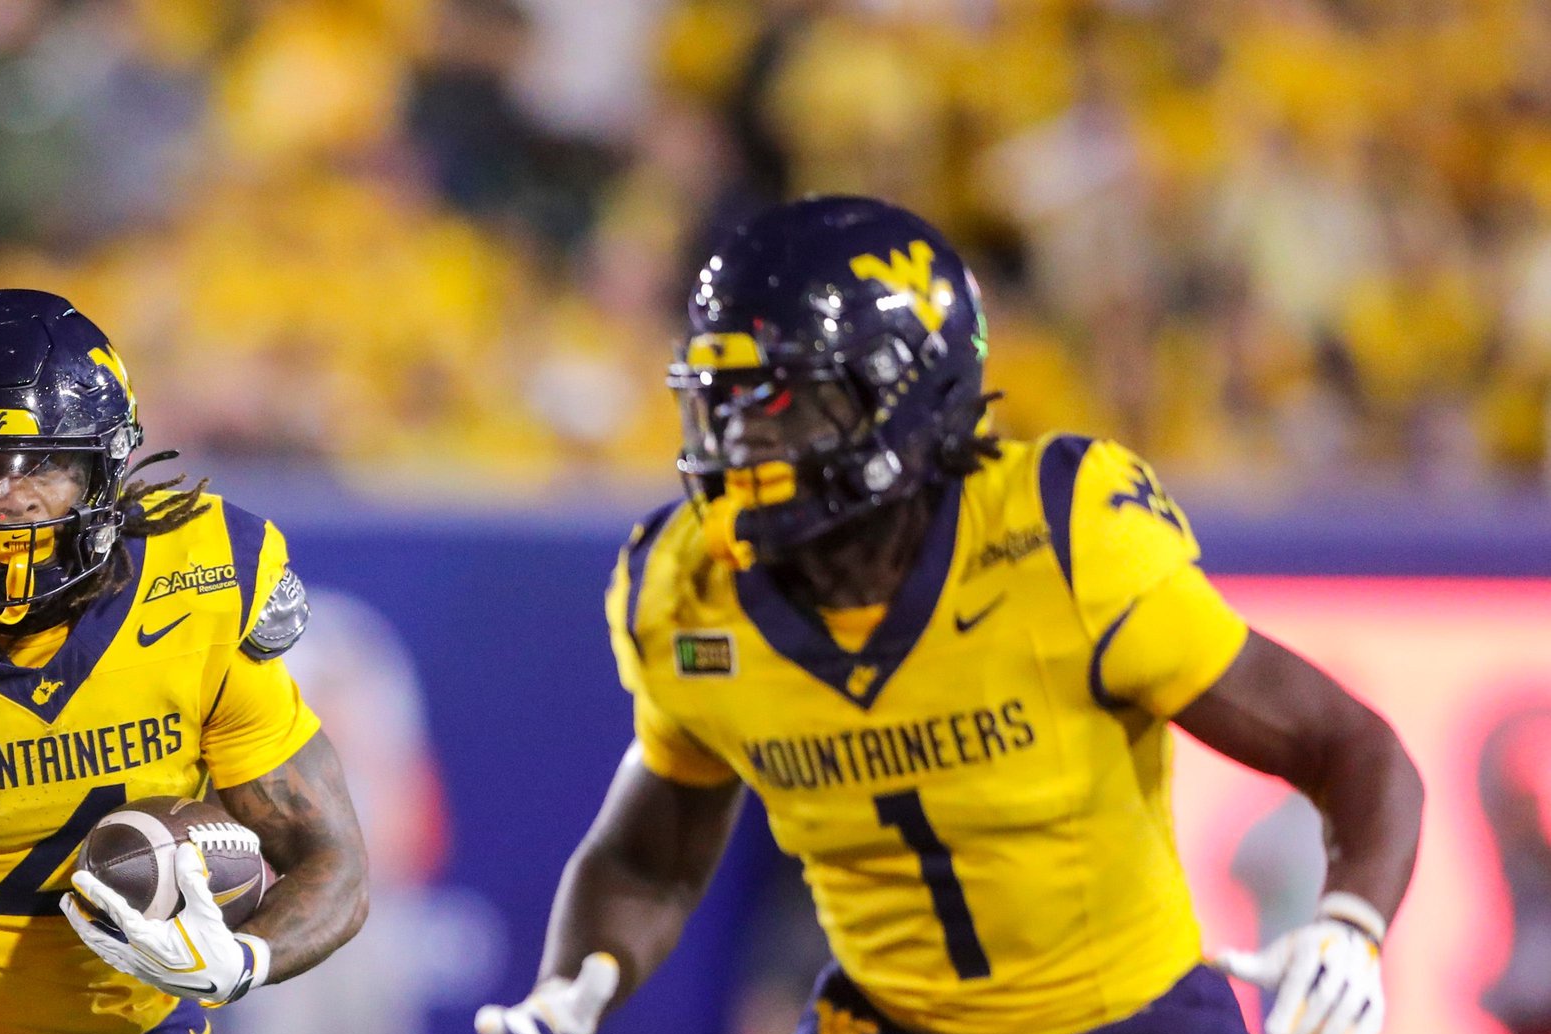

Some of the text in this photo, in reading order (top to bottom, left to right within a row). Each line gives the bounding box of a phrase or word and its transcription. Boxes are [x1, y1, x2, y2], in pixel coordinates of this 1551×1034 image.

[171, 565, 236, 592] Antero
[198, 580, 237, 594] Resources
[742, 700, 1036, 790] MOUNTAINEERS
[873, 787, 991, 981] 1
